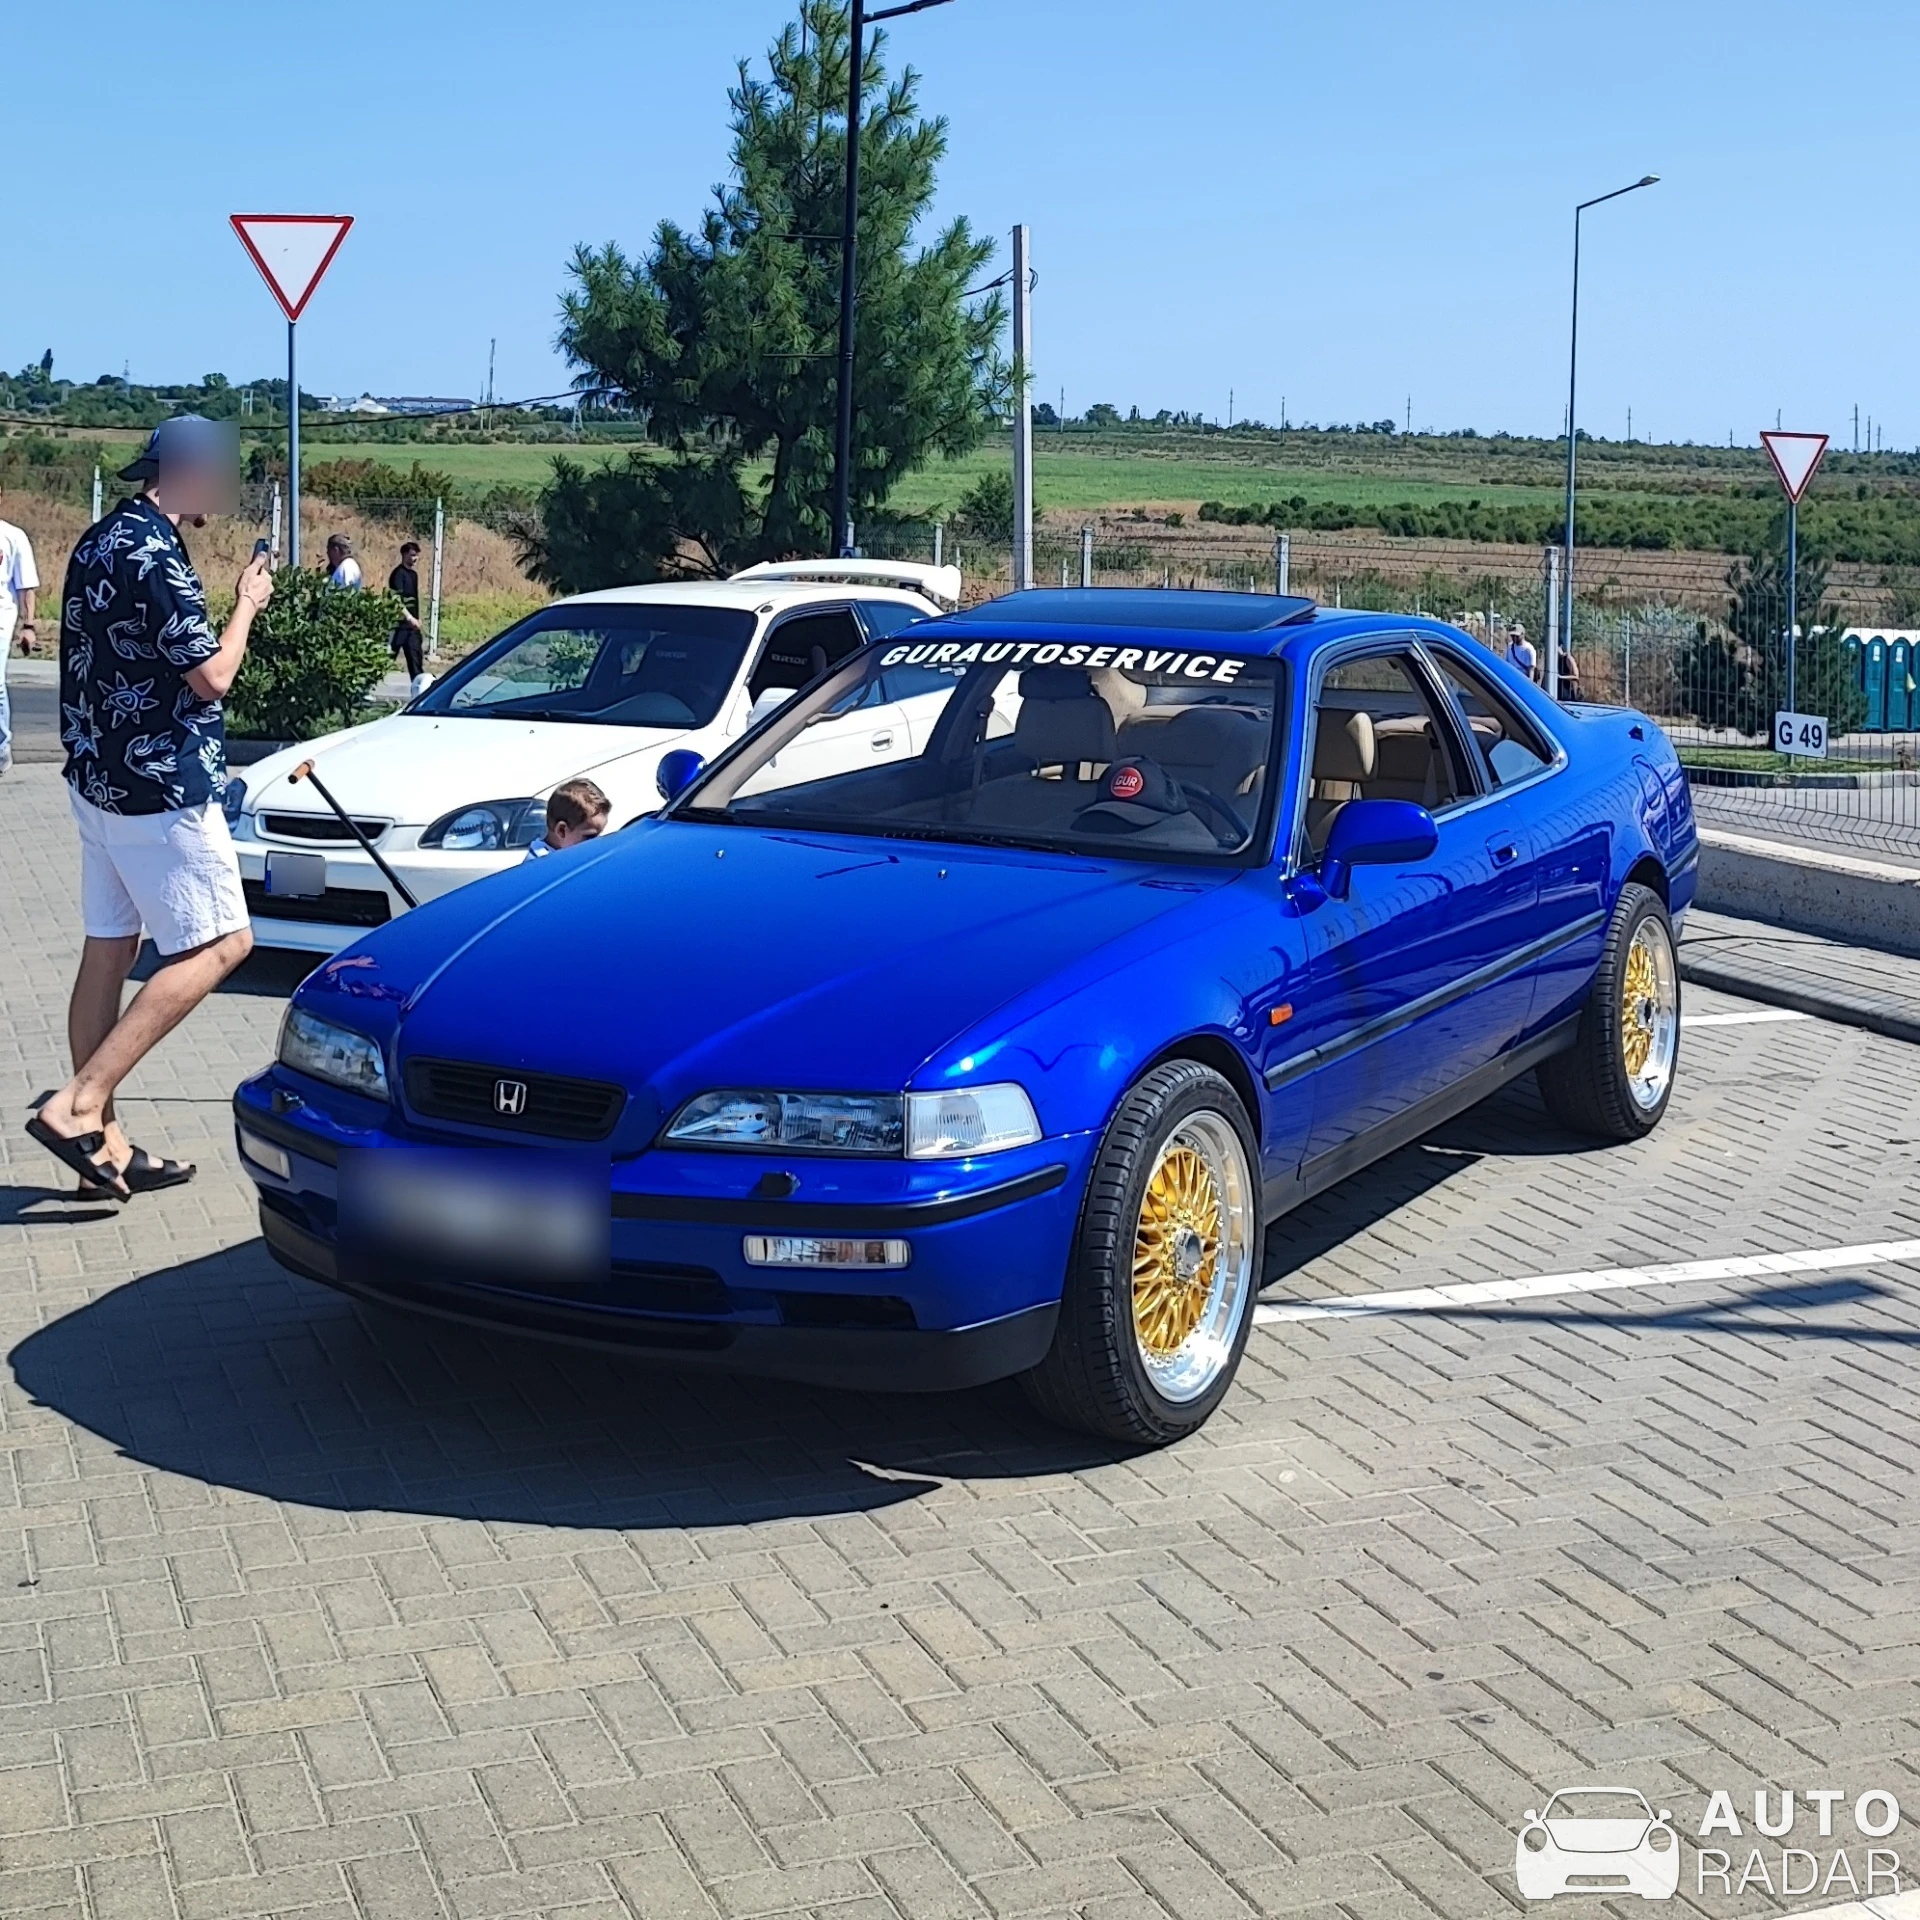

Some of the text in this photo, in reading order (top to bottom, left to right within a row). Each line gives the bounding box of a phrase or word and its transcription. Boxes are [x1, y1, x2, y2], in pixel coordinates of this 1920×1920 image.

[880, 642, 1246, 683] GURAUTOSERVICE
[1778, 720, 1823, 749] G 49
[1115, 775, 1138, 787] GUR
